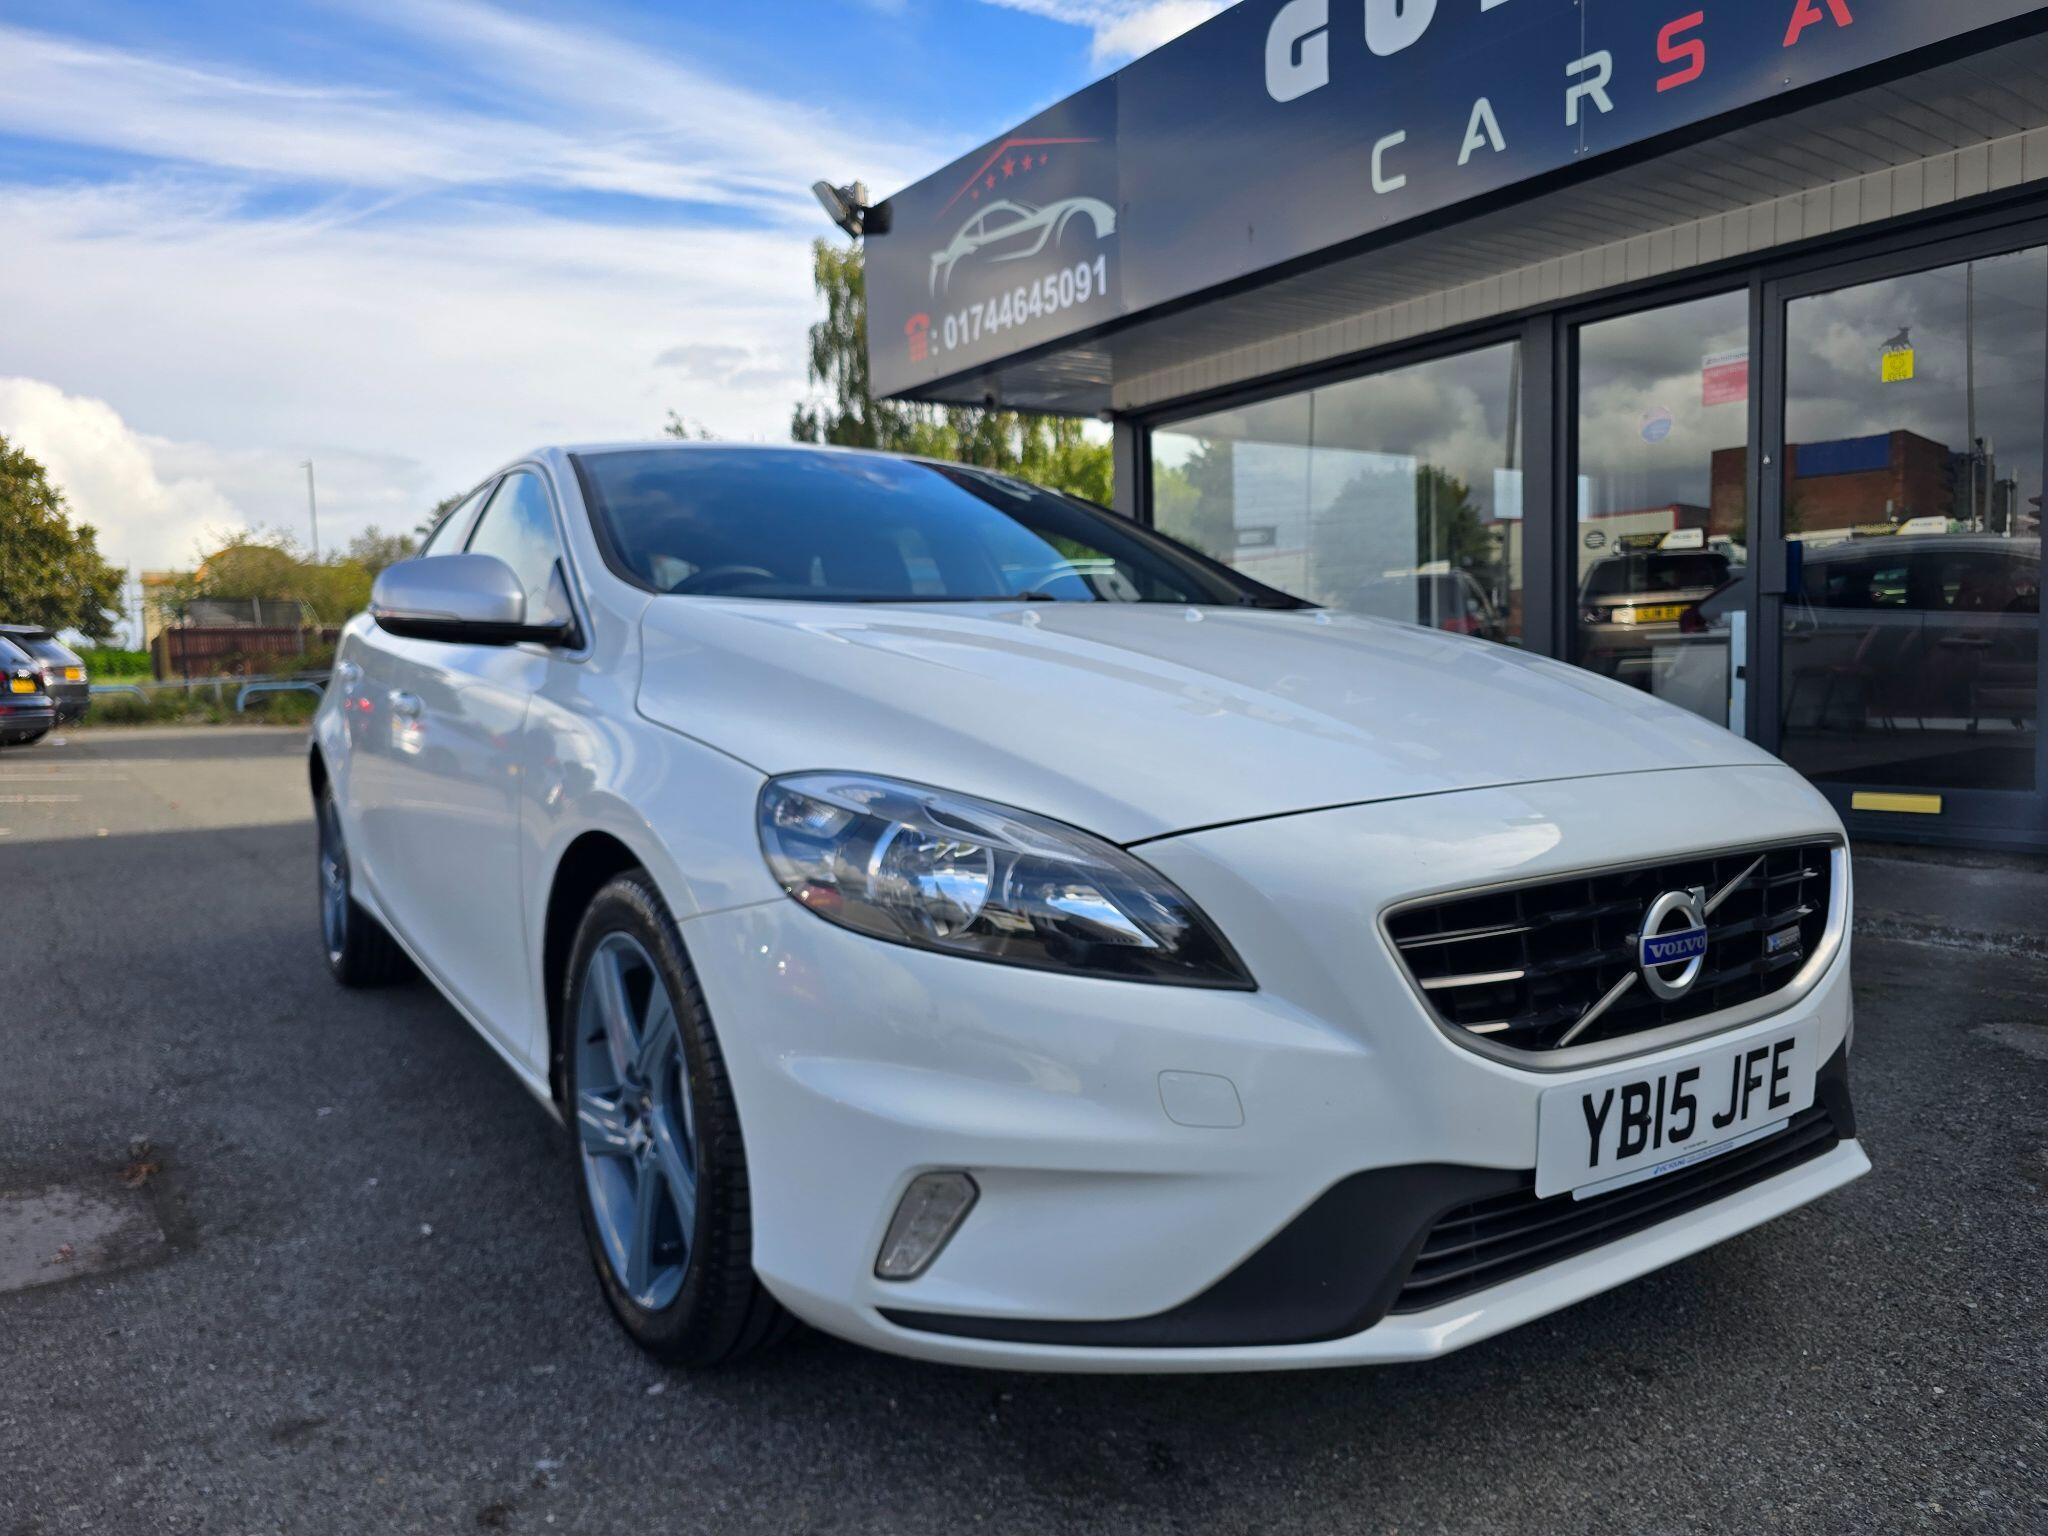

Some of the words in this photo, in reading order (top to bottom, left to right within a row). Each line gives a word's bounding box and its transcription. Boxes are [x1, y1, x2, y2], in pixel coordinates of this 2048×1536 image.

[1648, 934, 1706, 959] VOLVO
[1582, 1066, 1701, 1168] YB15
[1712, 1036, 1796, 1130] JFE
